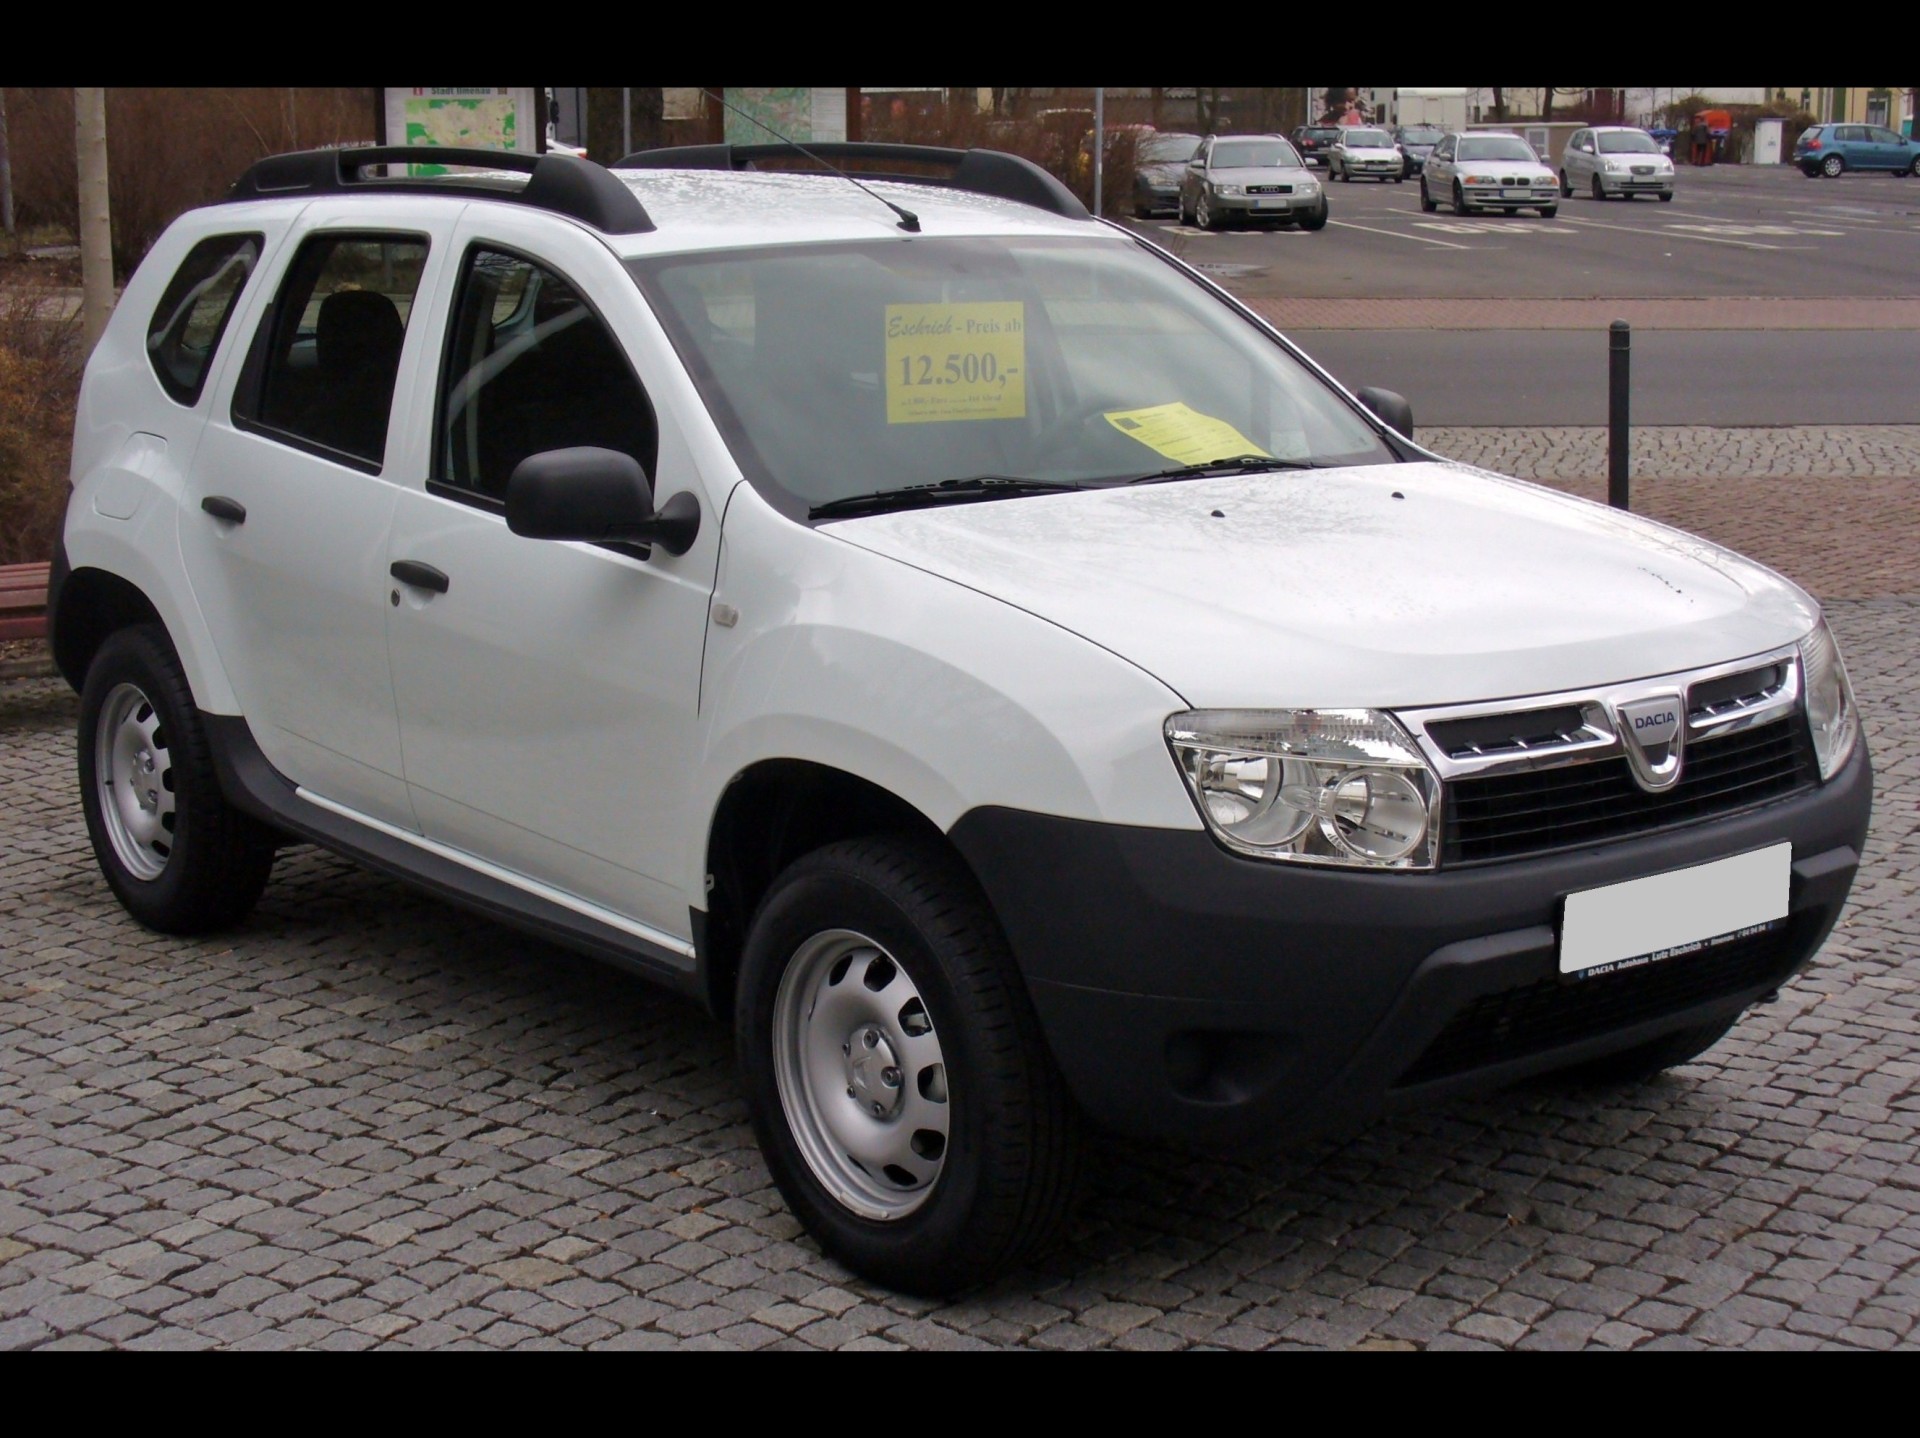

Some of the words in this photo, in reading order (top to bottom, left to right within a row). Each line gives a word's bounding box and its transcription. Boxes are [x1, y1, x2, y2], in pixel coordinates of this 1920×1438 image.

[887, 315, 953, 338] Eschrich
[966, 319, 1000, 334] Preis
[1004, 317, 1021, 332] ab
[900, 352, 1018, 389] 12.500,-
[1634, 711, 1675, 730] DACIA
[1587, 963, 1615, 977] DACIA
